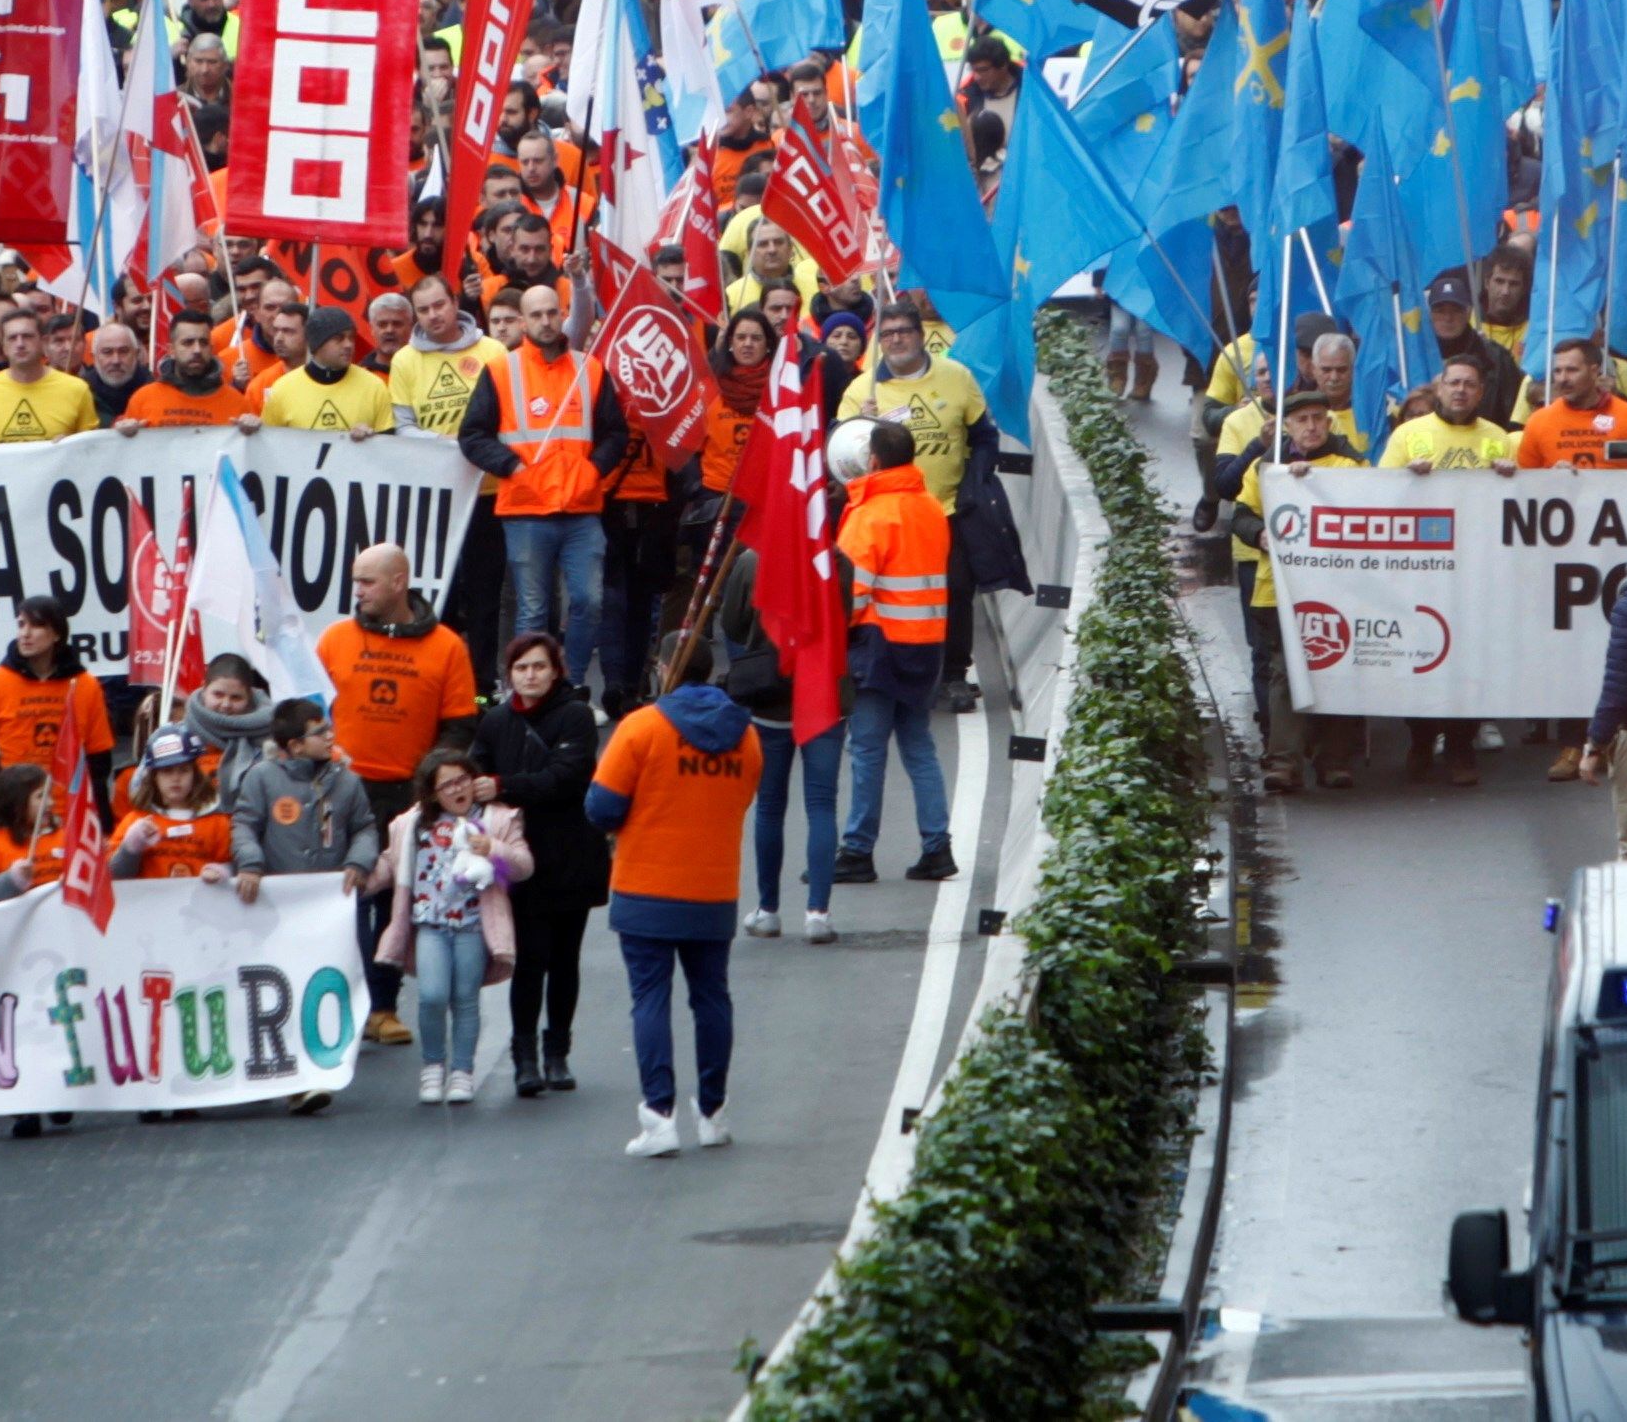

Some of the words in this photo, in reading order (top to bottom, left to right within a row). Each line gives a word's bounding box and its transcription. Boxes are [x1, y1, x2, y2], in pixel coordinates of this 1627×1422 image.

[624, 312, 688, 390] UGT
[1317, 514, 1416, 542] CCOO
[1502, 497, 1574, 547] NO
[1360, 555, 1380, 570] de
[1385, 556, 1456, 572] industria
[1354, 618, 1403, 639] FICA
[678, 753, 744, 778] NON
